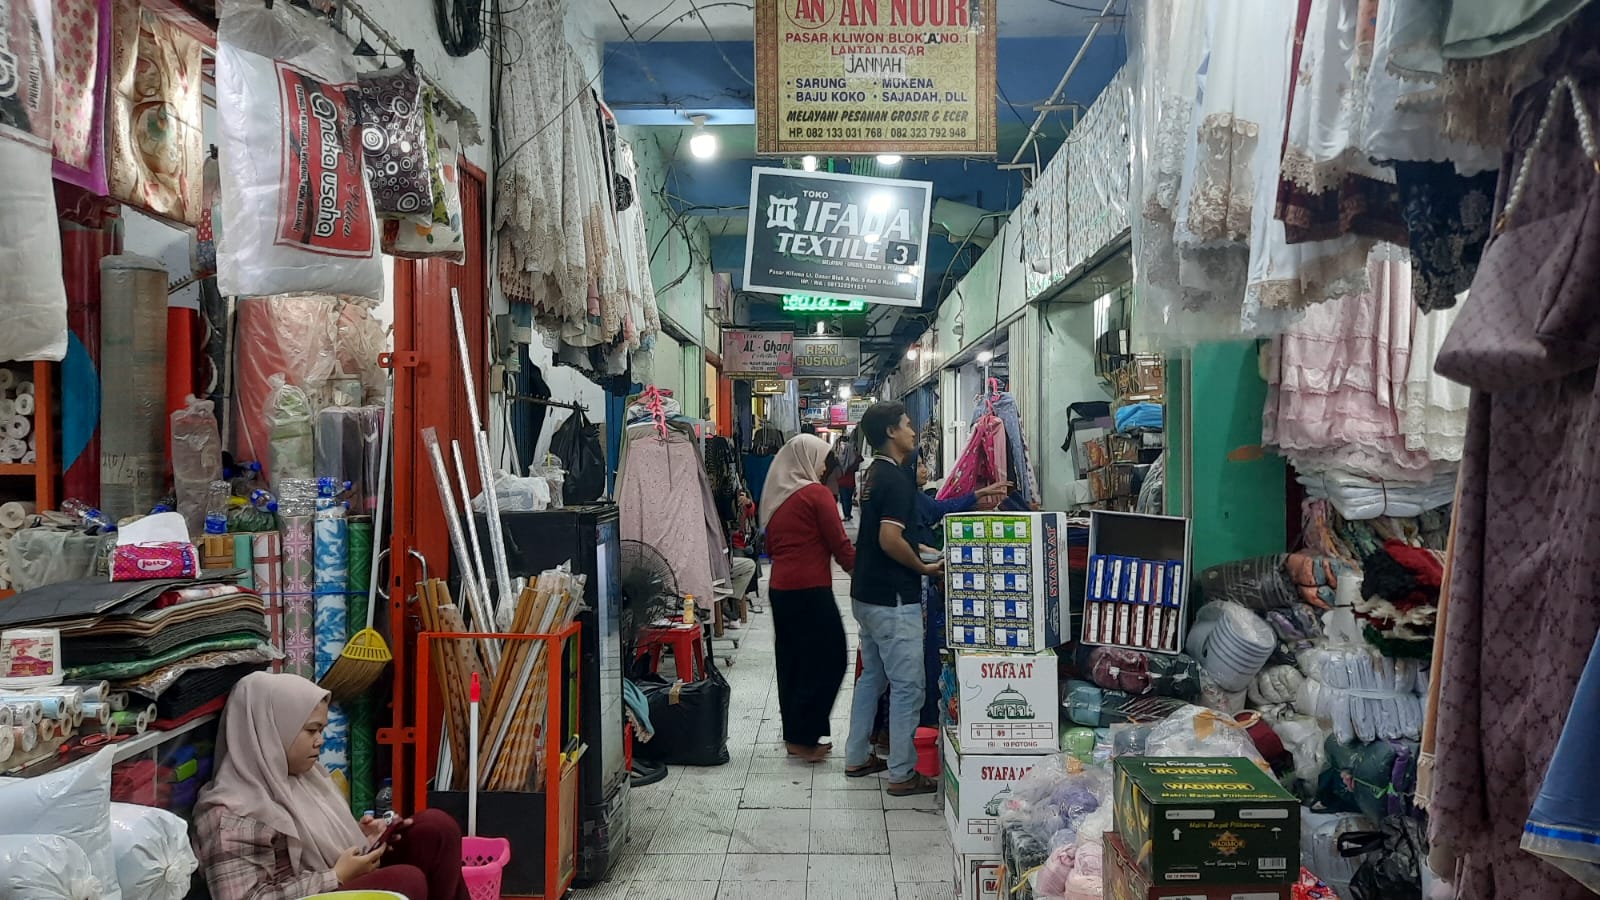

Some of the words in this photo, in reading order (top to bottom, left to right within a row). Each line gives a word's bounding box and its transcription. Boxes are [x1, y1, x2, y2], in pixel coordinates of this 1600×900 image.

[838, 0, 877, 26] AN
[785, 33, 828, 43] PASAR
[833, 33, 884, 43] KLIWON
[889, 33, 921, 43] BLOK
[940, 33, 962, 43] NO.
[881, 46, 925, 56] DASAR
[796, 79, 846, 89] SARUNG
[882, 79, 934, 89] MUKENA
[796, 91, 827, 102] BAJU
[832, 91, 865, 102] KOKO
[882, 91, 941, 103] SAJADAH,
[945, 91, 968, 102] DLL
[786, 110, 838, 122] MELAYANI
[841, 110, 888, 122] PESANAN
[891, 110, 930, 122] GROSIR
[931, 110, 940, 122] &
[943, 110, 968, 122] ECER
[789, 127, 804, 138] HP.
[806, 127, 823, 138] 082
[826, 127, 843, 138] 133
[846, 127, 862, 138] 031
[865, 127, 882, 138] 768
[890, 127, 907, 138] 082
[910, 127, 927, 138] 323
[929, 127, 947, 138] 792
[949, 127, 966, 138] 948
[803, 190, 829, 199] TOKO
[314, 171, 341, 237] usaha
[803, 200, 911, 241] IFADA
[777, 232, 880, 261] TEXTILE
[893, 245, 909, 265] 3
[806, 343, 838, 355] RIZKI
[796, 355, 849, 367] BUSANA
[981, 662, 1034, 678] SYAFA'AT
[1209, 840, 1246, 848] WADIMOR
